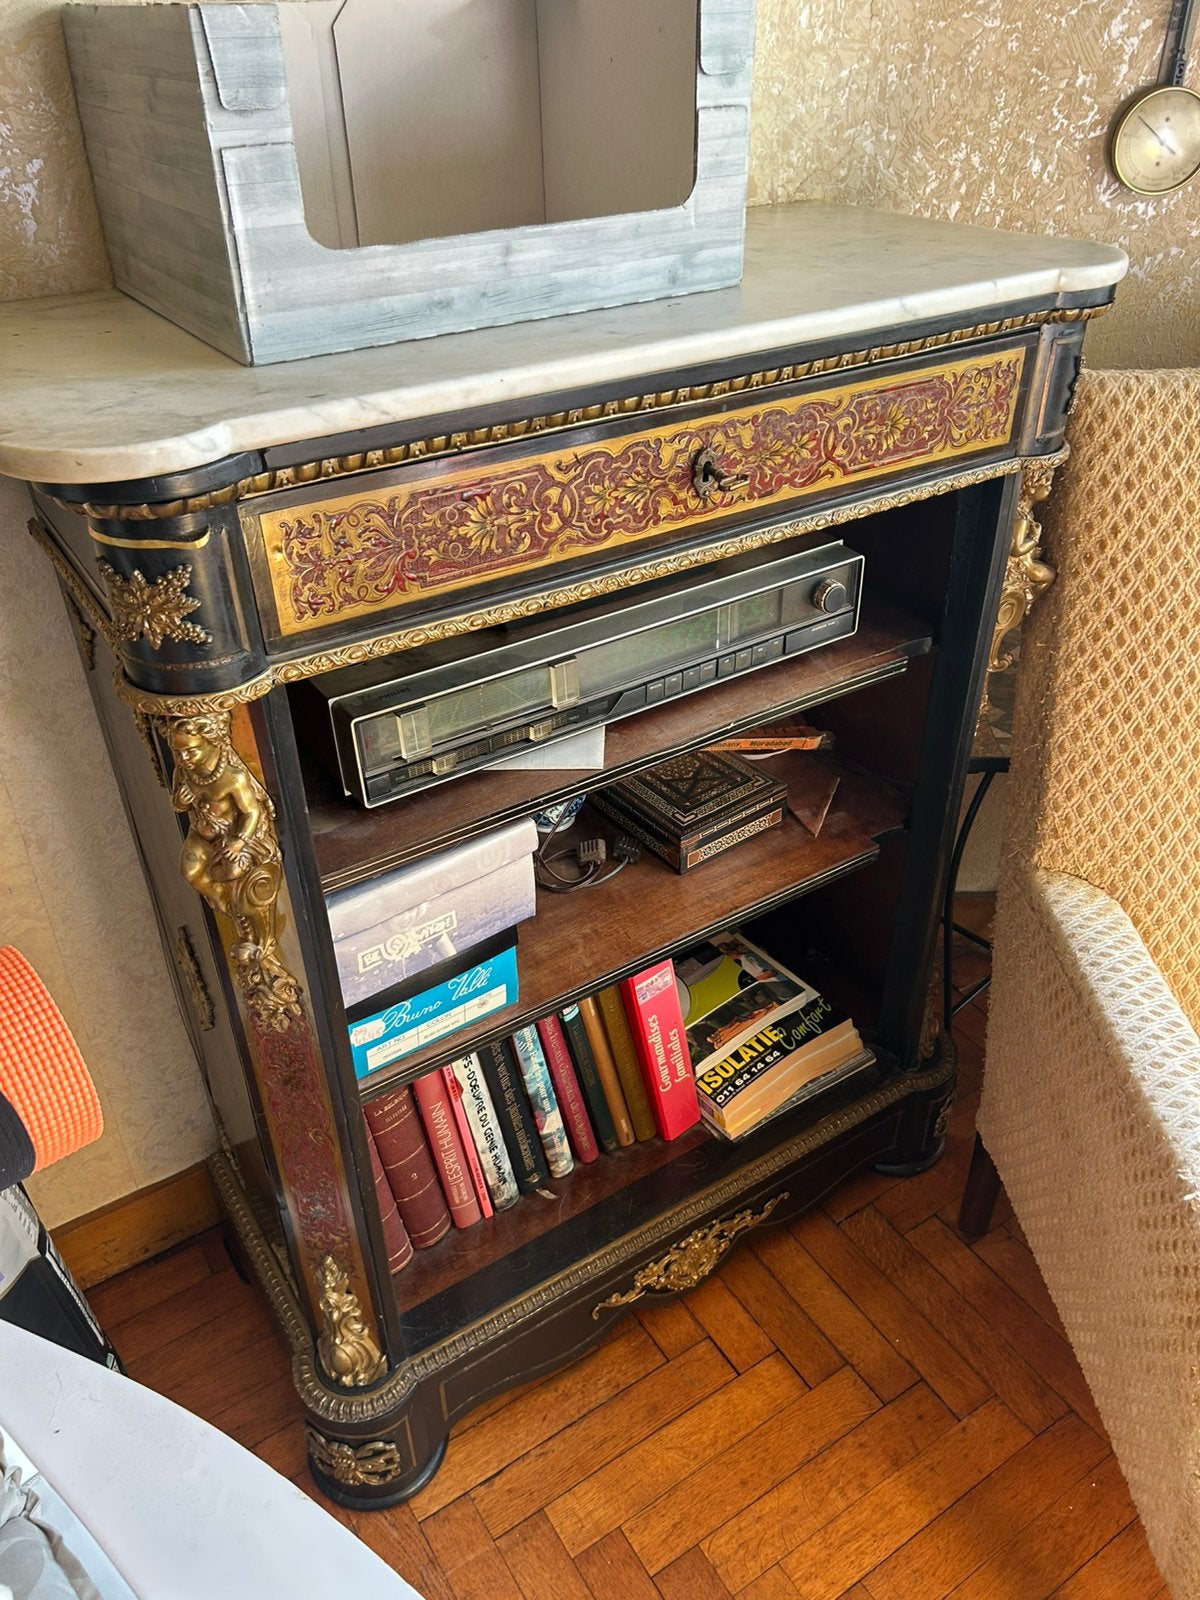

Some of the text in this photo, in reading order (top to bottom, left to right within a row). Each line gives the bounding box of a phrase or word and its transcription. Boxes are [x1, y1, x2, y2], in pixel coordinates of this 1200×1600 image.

[382, 999, 443, 1034] Bruno
[777, 997, 831, 1049] Comfort
[648, 1014, 672, 1093] Gourmandises
[668, 1028, 690, 1082] familiales
[696, 1026, 784, 1095] ISOLATIE
[497, 1063, 512, 1091] vertus
[716, 1050, 781, 1103] 011 64 14 64
[504, 1087, 516, 1105] des
[536, 1081, 549, 1100] pour
[543, 1098, 553, 1113] une
[570, 1100, 579, 1114] de
[429, 1101, 453, 1150] HUMAIN
[463, 1055, 508, 1186] FS-D'OEUVRE DU GENIE HUMAIN
[506, 1102, 524, 1132] plantes
[574, 1112, 590, 1150] Belgique
[441, 1149, 464, 1185] L'ESPRIT
